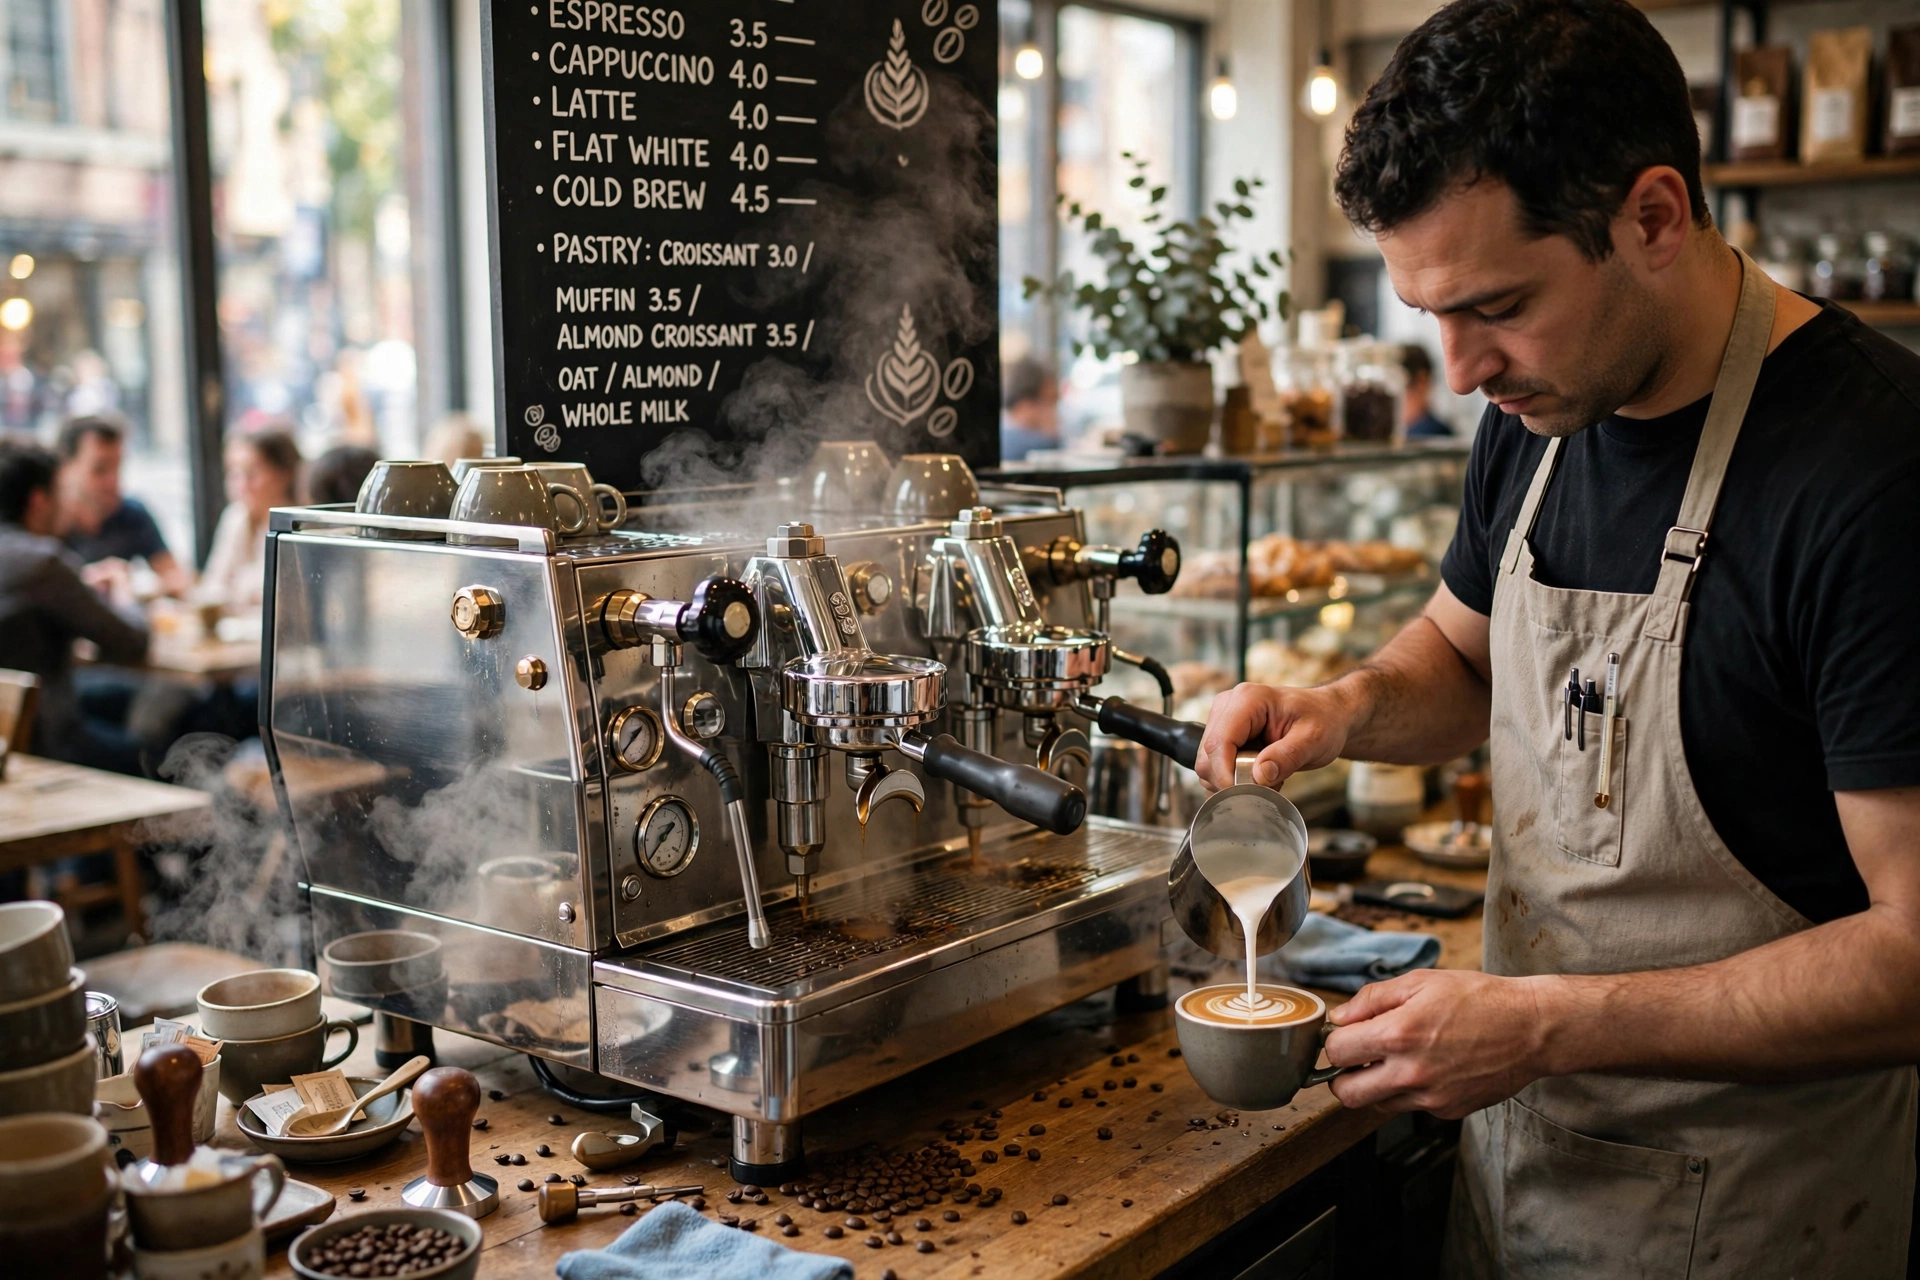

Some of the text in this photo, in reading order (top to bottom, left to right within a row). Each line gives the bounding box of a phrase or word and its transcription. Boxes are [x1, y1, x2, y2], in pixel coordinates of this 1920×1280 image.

[549, 0, 768, 49] ESPRESSO 3.5
[549, 41, 768, 90] CAPPUCCINO 4.0
[552, 85, 769, 131] LATTE 4.0
[552, 130, 769, 171] FLAT WHITE 4.0
[552, 174, 770, 213] COLD BREW 4.5
[553, 232, 651, 265] PASTRY:
[658, 239, 760, 267] CROISSANT
[767, 243, 798, 268] 3.0
[556, 286, 636, 313] MUFFIN
[648, 287, 682, 312] 3.5
[556, 323, 644, 351] ALMOND
[650, 322, 757, 349] CROISSANT
[766, 323, 797, 347] 3.5
[558, 366, 599, 392] OAT
[622, 363, 703, 389] ALMOND
[561, 399, 690, 428] WHOLE MILK
